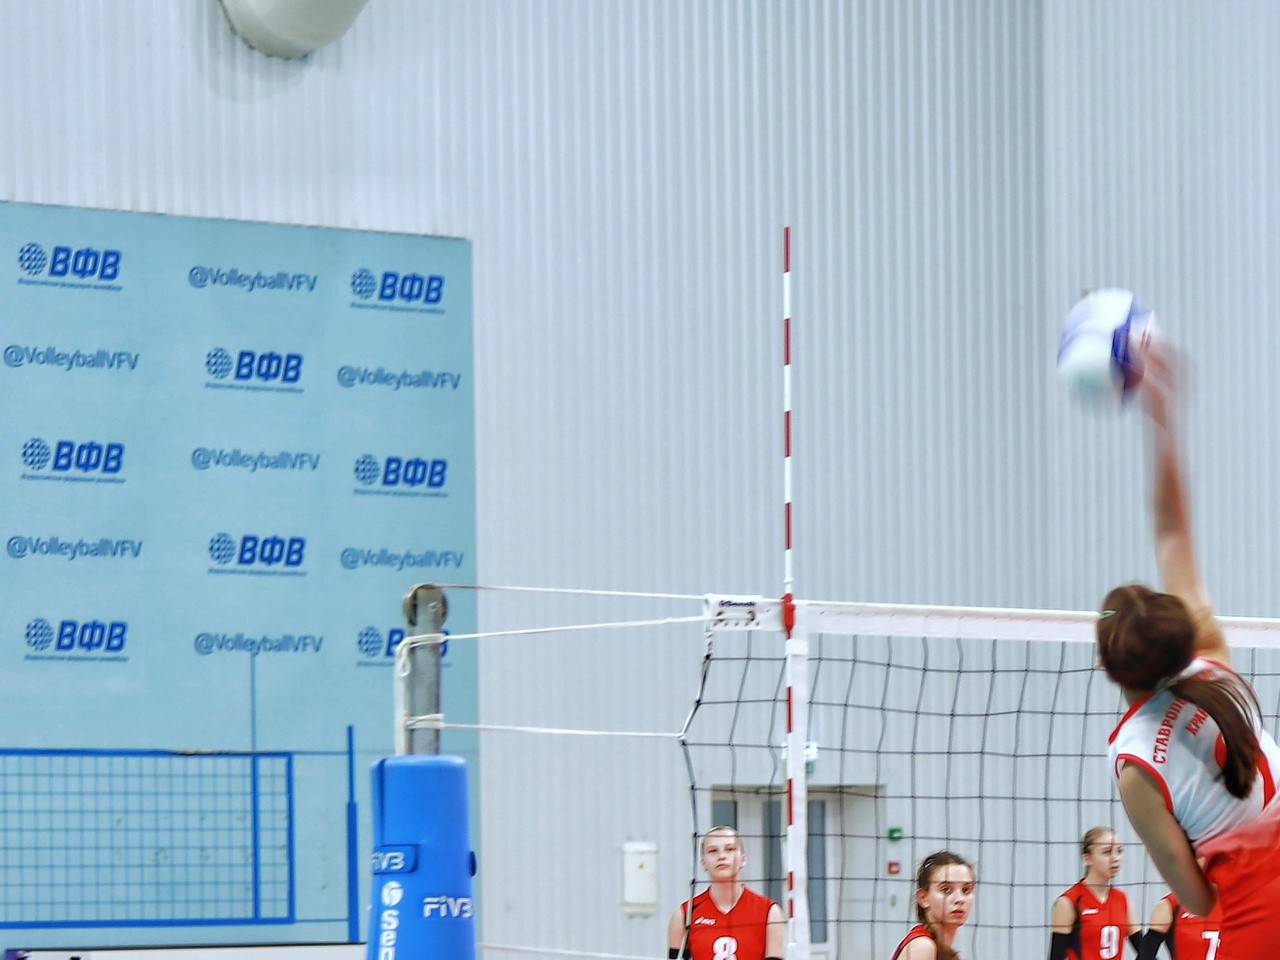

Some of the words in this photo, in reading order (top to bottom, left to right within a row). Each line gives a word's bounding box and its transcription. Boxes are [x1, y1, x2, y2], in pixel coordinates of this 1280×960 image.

[49, 246, 121, 281] ВФВ
[188, 265, 318, 293] @VolleyballVFV
[379, 272, 444, 304] ВФВ
[3, 344, 140, 371] @VolleyballVFV
[235, 350, 303, 383] ВФВ
[336, 366, 461, 391] @VolleyballVFV
[53, 441, 124, 473] ВФВ
[190, 447, 320, 473] @VolleyballVFV
[382, 457, 447, 488] ВФВ
[7, 535, 143, 561] @VolleyballVFV
[238, 536, 305, 567] ВФВ
[340, 547, 465, 571] @VolleyballVFV
[56, 621, 127, 652] ВФВ
[194, 632, 324, 658] @VolleyballVFV
[1099, 925, 1120, 960] 9
